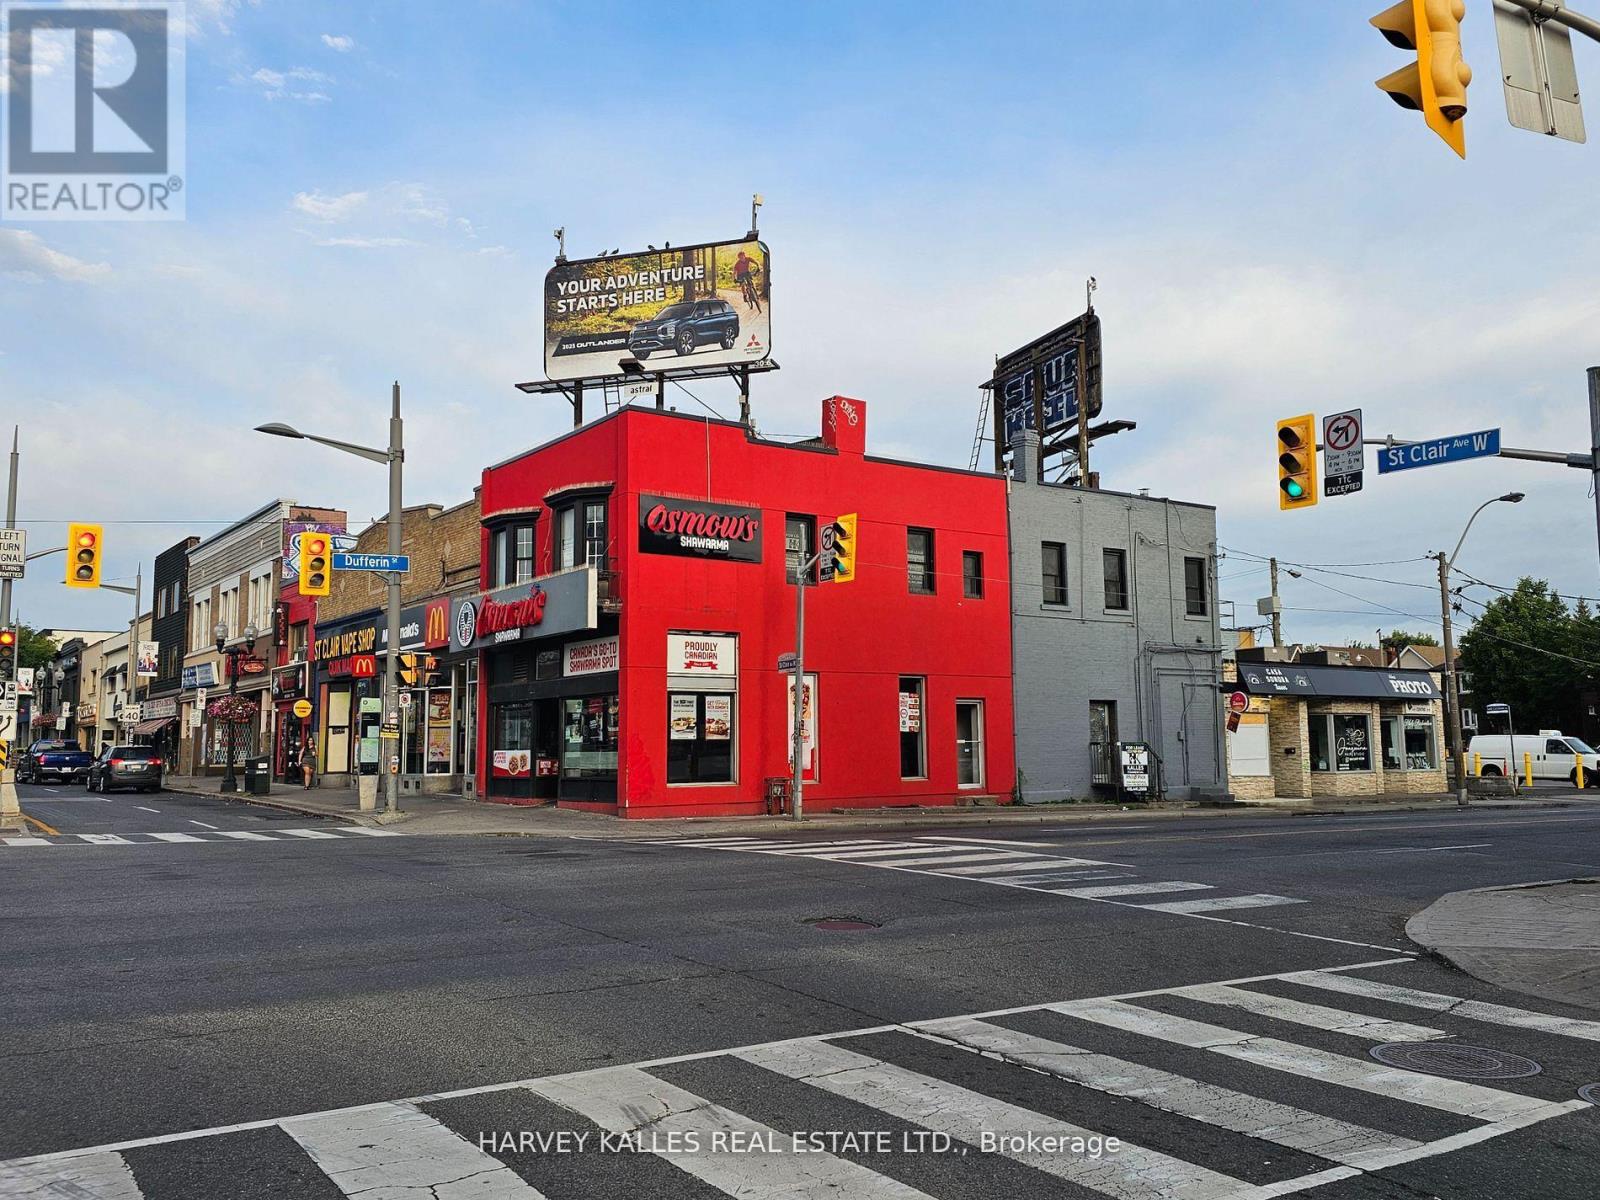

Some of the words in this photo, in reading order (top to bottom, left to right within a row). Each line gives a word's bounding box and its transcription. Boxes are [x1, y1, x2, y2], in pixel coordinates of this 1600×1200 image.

[556, 278, 604, 296] YOUR
[605, 265, 705, 290] ADVENTURE
[556, 293, 618, 314] STARTS
[622, 287, 666, 306] HERE
[576, 338, 626, 348] OUTLANDER
[630, 385, 653, 394] astral
[1388, 450, 1405, 466] St
[1410, 442, 1450, 462] Clair
[1452, 439, 1470, 448] Ave
[1472, 433, 1488, 452] W
[1337, 475, 1352, 485] TTC
[1327, 481, 1361, 494] EXCEPTED
[647, 503, 759, 542] Osmow's
[680, 535, 730, 551] SHAWARMA
[345, 555, 390, 568] Dufferin
[381, 622, 420, 644] Mnald's
[314, 639, 322, 661] ST
[322, 636, 340, 659] CLAIR
[341, 631, 358, 654] VAPE
[358, 627, 376, 652] SHOP
[569, 644, 598, 660] CANADA'S
[598, 641, 617, 655] GO-TO
[684, 641, 718, 651] PROUDLY
[684, 651, 718, 660] CANADIAN
[569, 658, 601, 672] SHAWARMA
[601, 655, 617, 669] SPOT
[1265, 668, 1283, 676] CASA
[125, 711, 139, 721] 40
